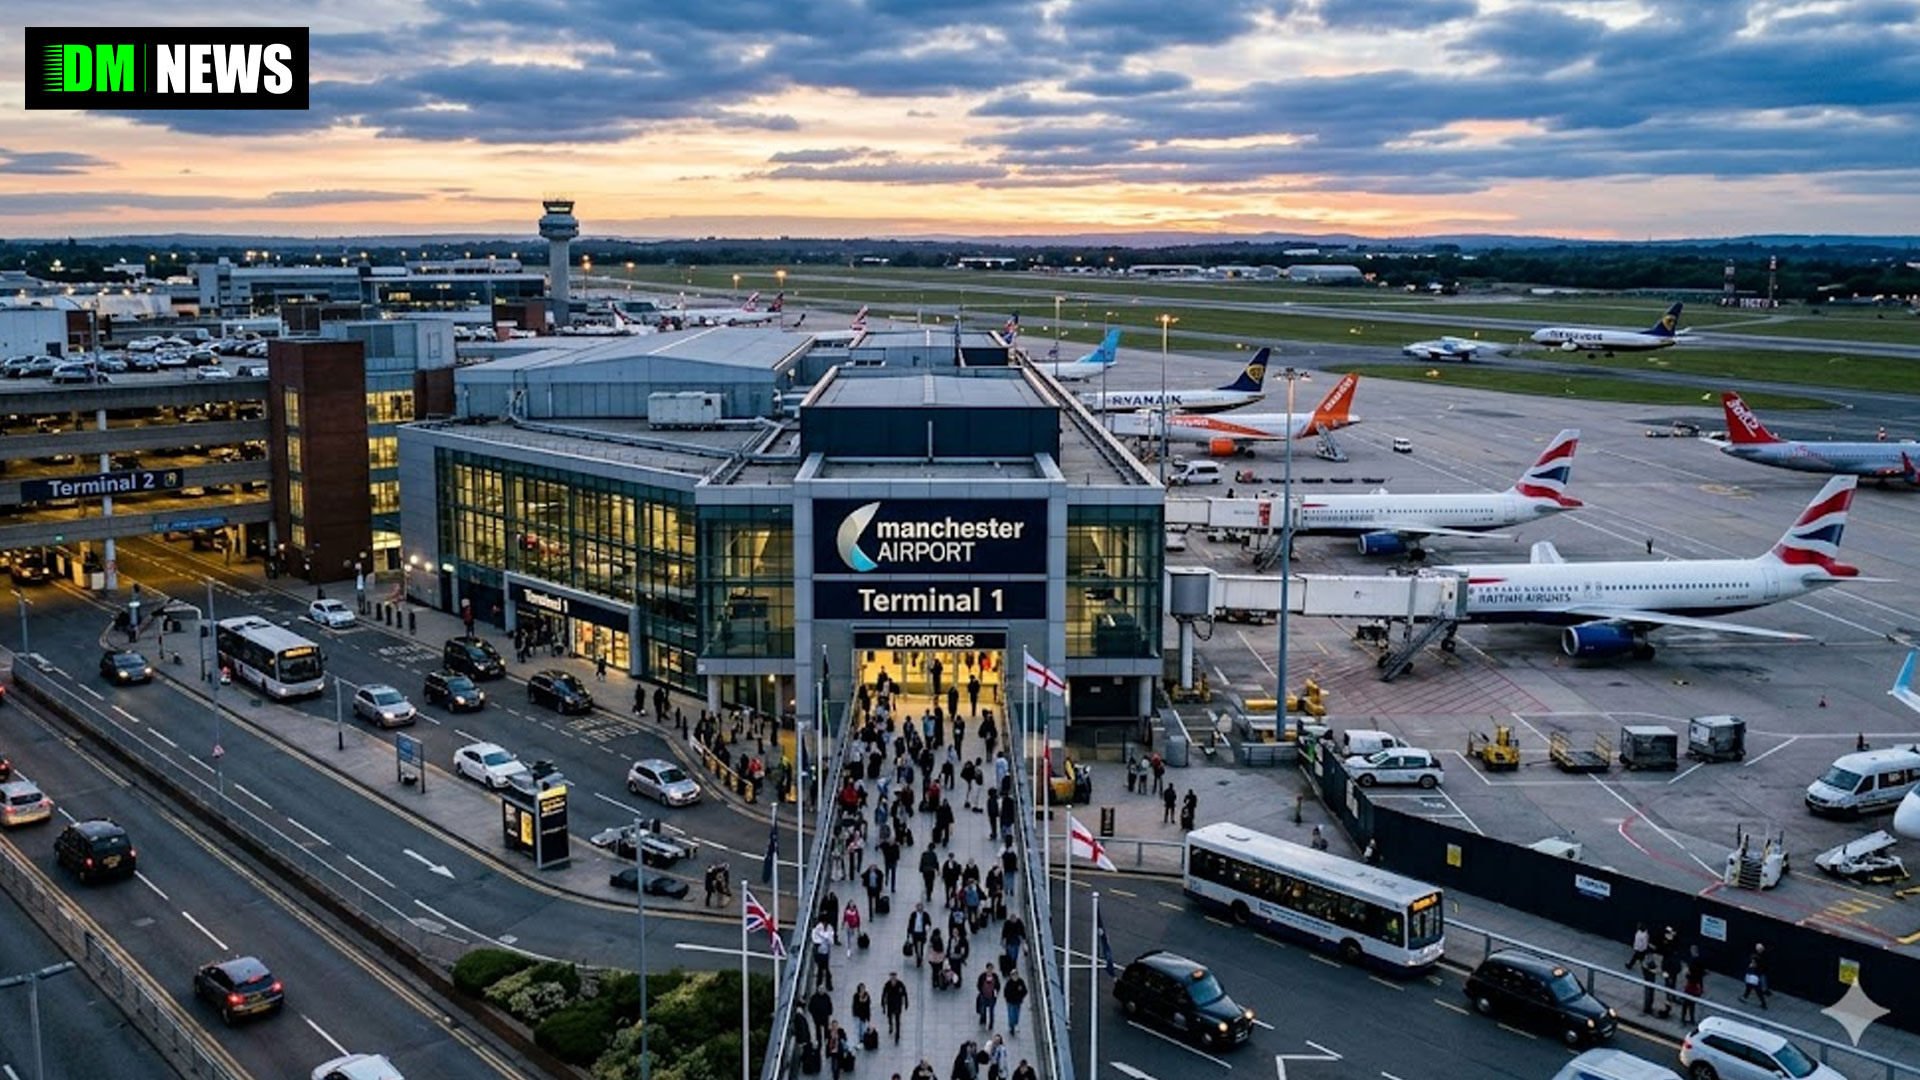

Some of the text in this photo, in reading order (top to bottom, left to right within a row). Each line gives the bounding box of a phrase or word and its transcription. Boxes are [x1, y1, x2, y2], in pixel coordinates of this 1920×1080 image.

[47, 474, 156, 498] Terminal 2
[876, 516, 1025, 539] manchester
[876, 541, 976, 563] AIRPORT
[857, 586, 1004, 613] Terminal 1
[885, 633, 975, 648] DEPARTURES
